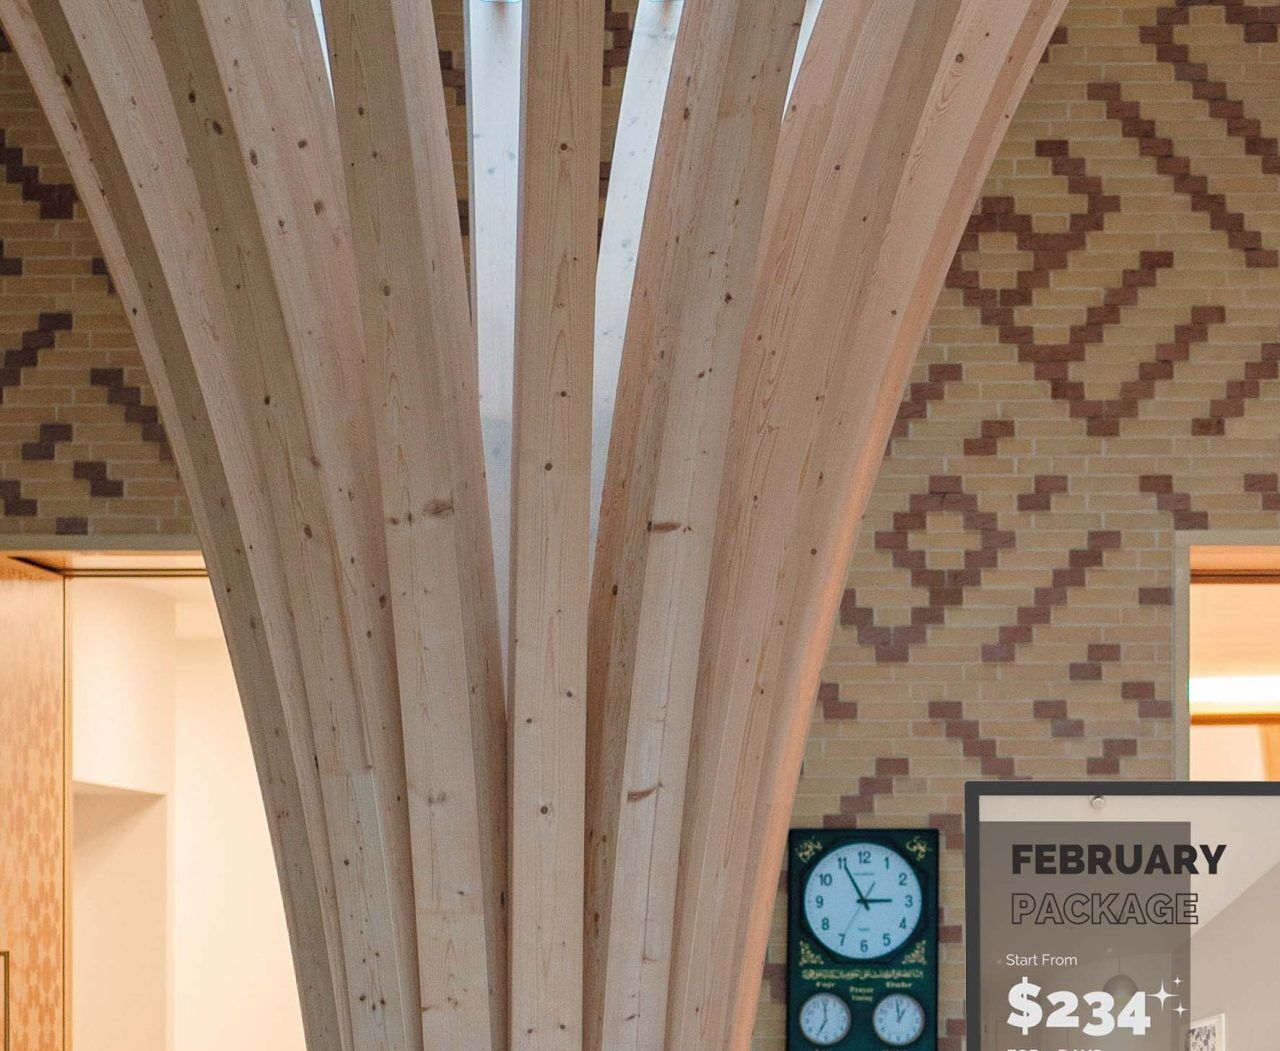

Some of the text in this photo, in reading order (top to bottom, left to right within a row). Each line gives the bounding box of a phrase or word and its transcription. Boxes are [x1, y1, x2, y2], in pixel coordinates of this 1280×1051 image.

[838, 857, 848, 870] 11
[857, 850, 871, 864] 12
[884, 857, 890, 870] 1
[1012, 844, 1227, 874] FEBRUARY
[819, 873, 833, 886] 10
[898, 873, 907, 886] 2
[815, 895, 824, 908] 9
[905, 894, 914, 908] 3
[1011, 893, 1199, 925] PACKAGE
[821, 917, 830, 931] 8
[899, 917, 907, 930] 4
[838, 933, 846, 947] 7
[860, 939, 868, 952] 6
[882, 933, 891, 946] 5
[1006, 954, 1078, 966] Start From
[1006, 976, 1151, 1037] $234
